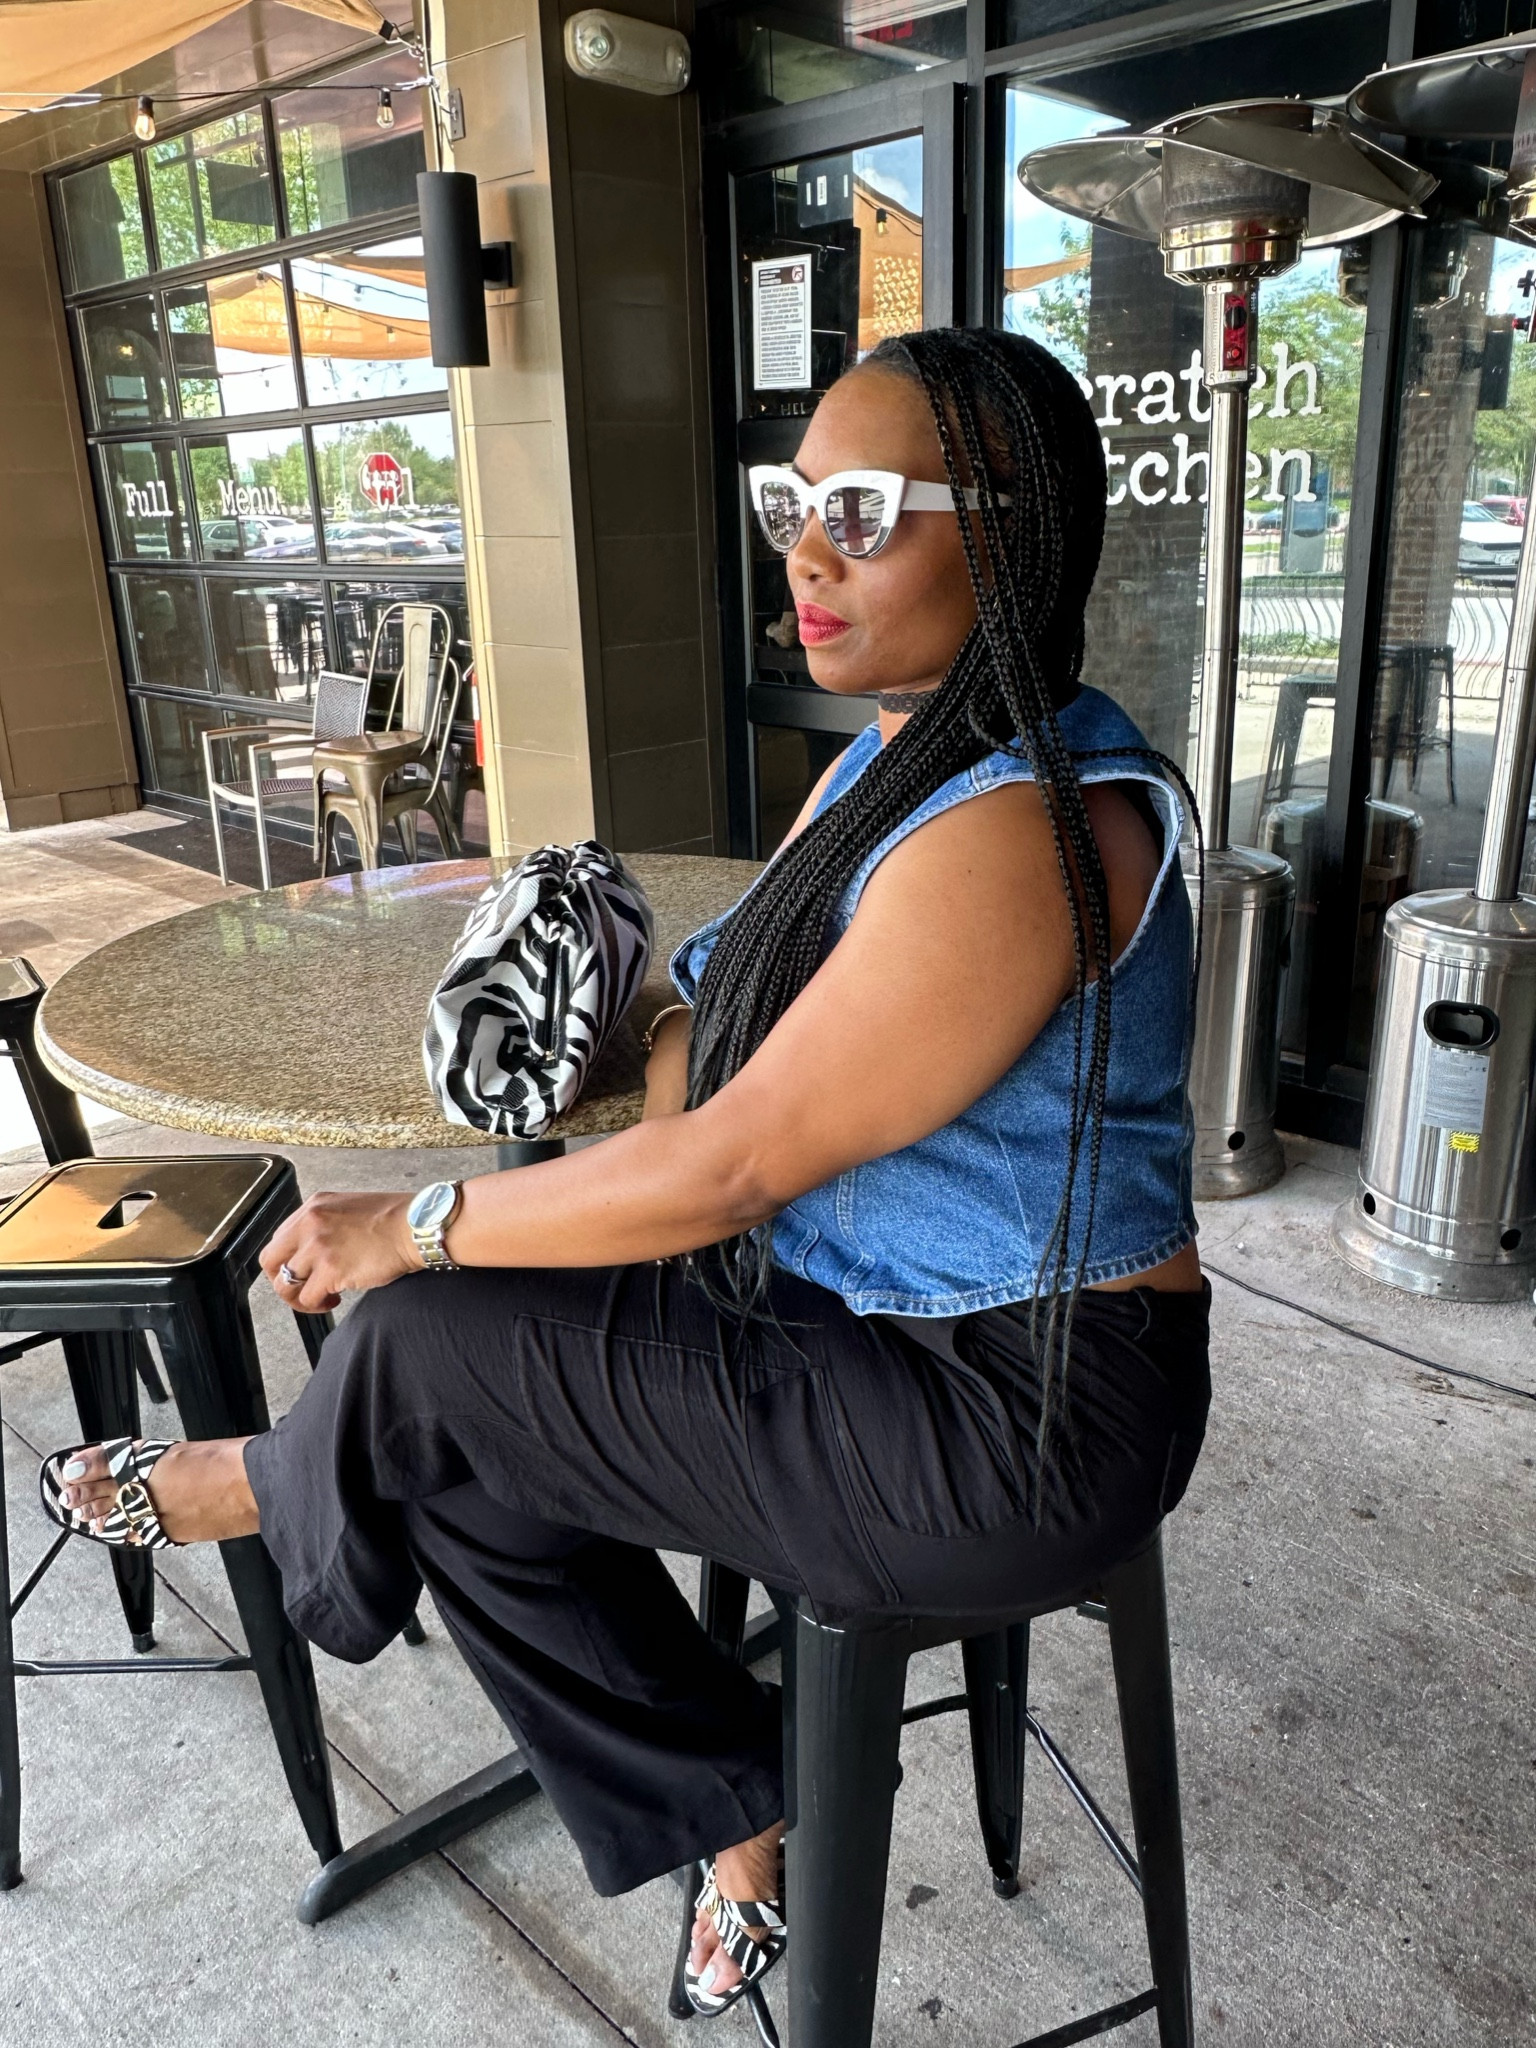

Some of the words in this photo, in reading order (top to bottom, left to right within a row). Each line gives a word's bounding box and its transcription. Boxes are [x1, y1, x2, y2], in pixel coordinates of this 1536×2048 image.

[1080, 342, 1321, 426] rath
[122, 480, 174, 517] Full
[1107, 433, 1316, 505] tchn
